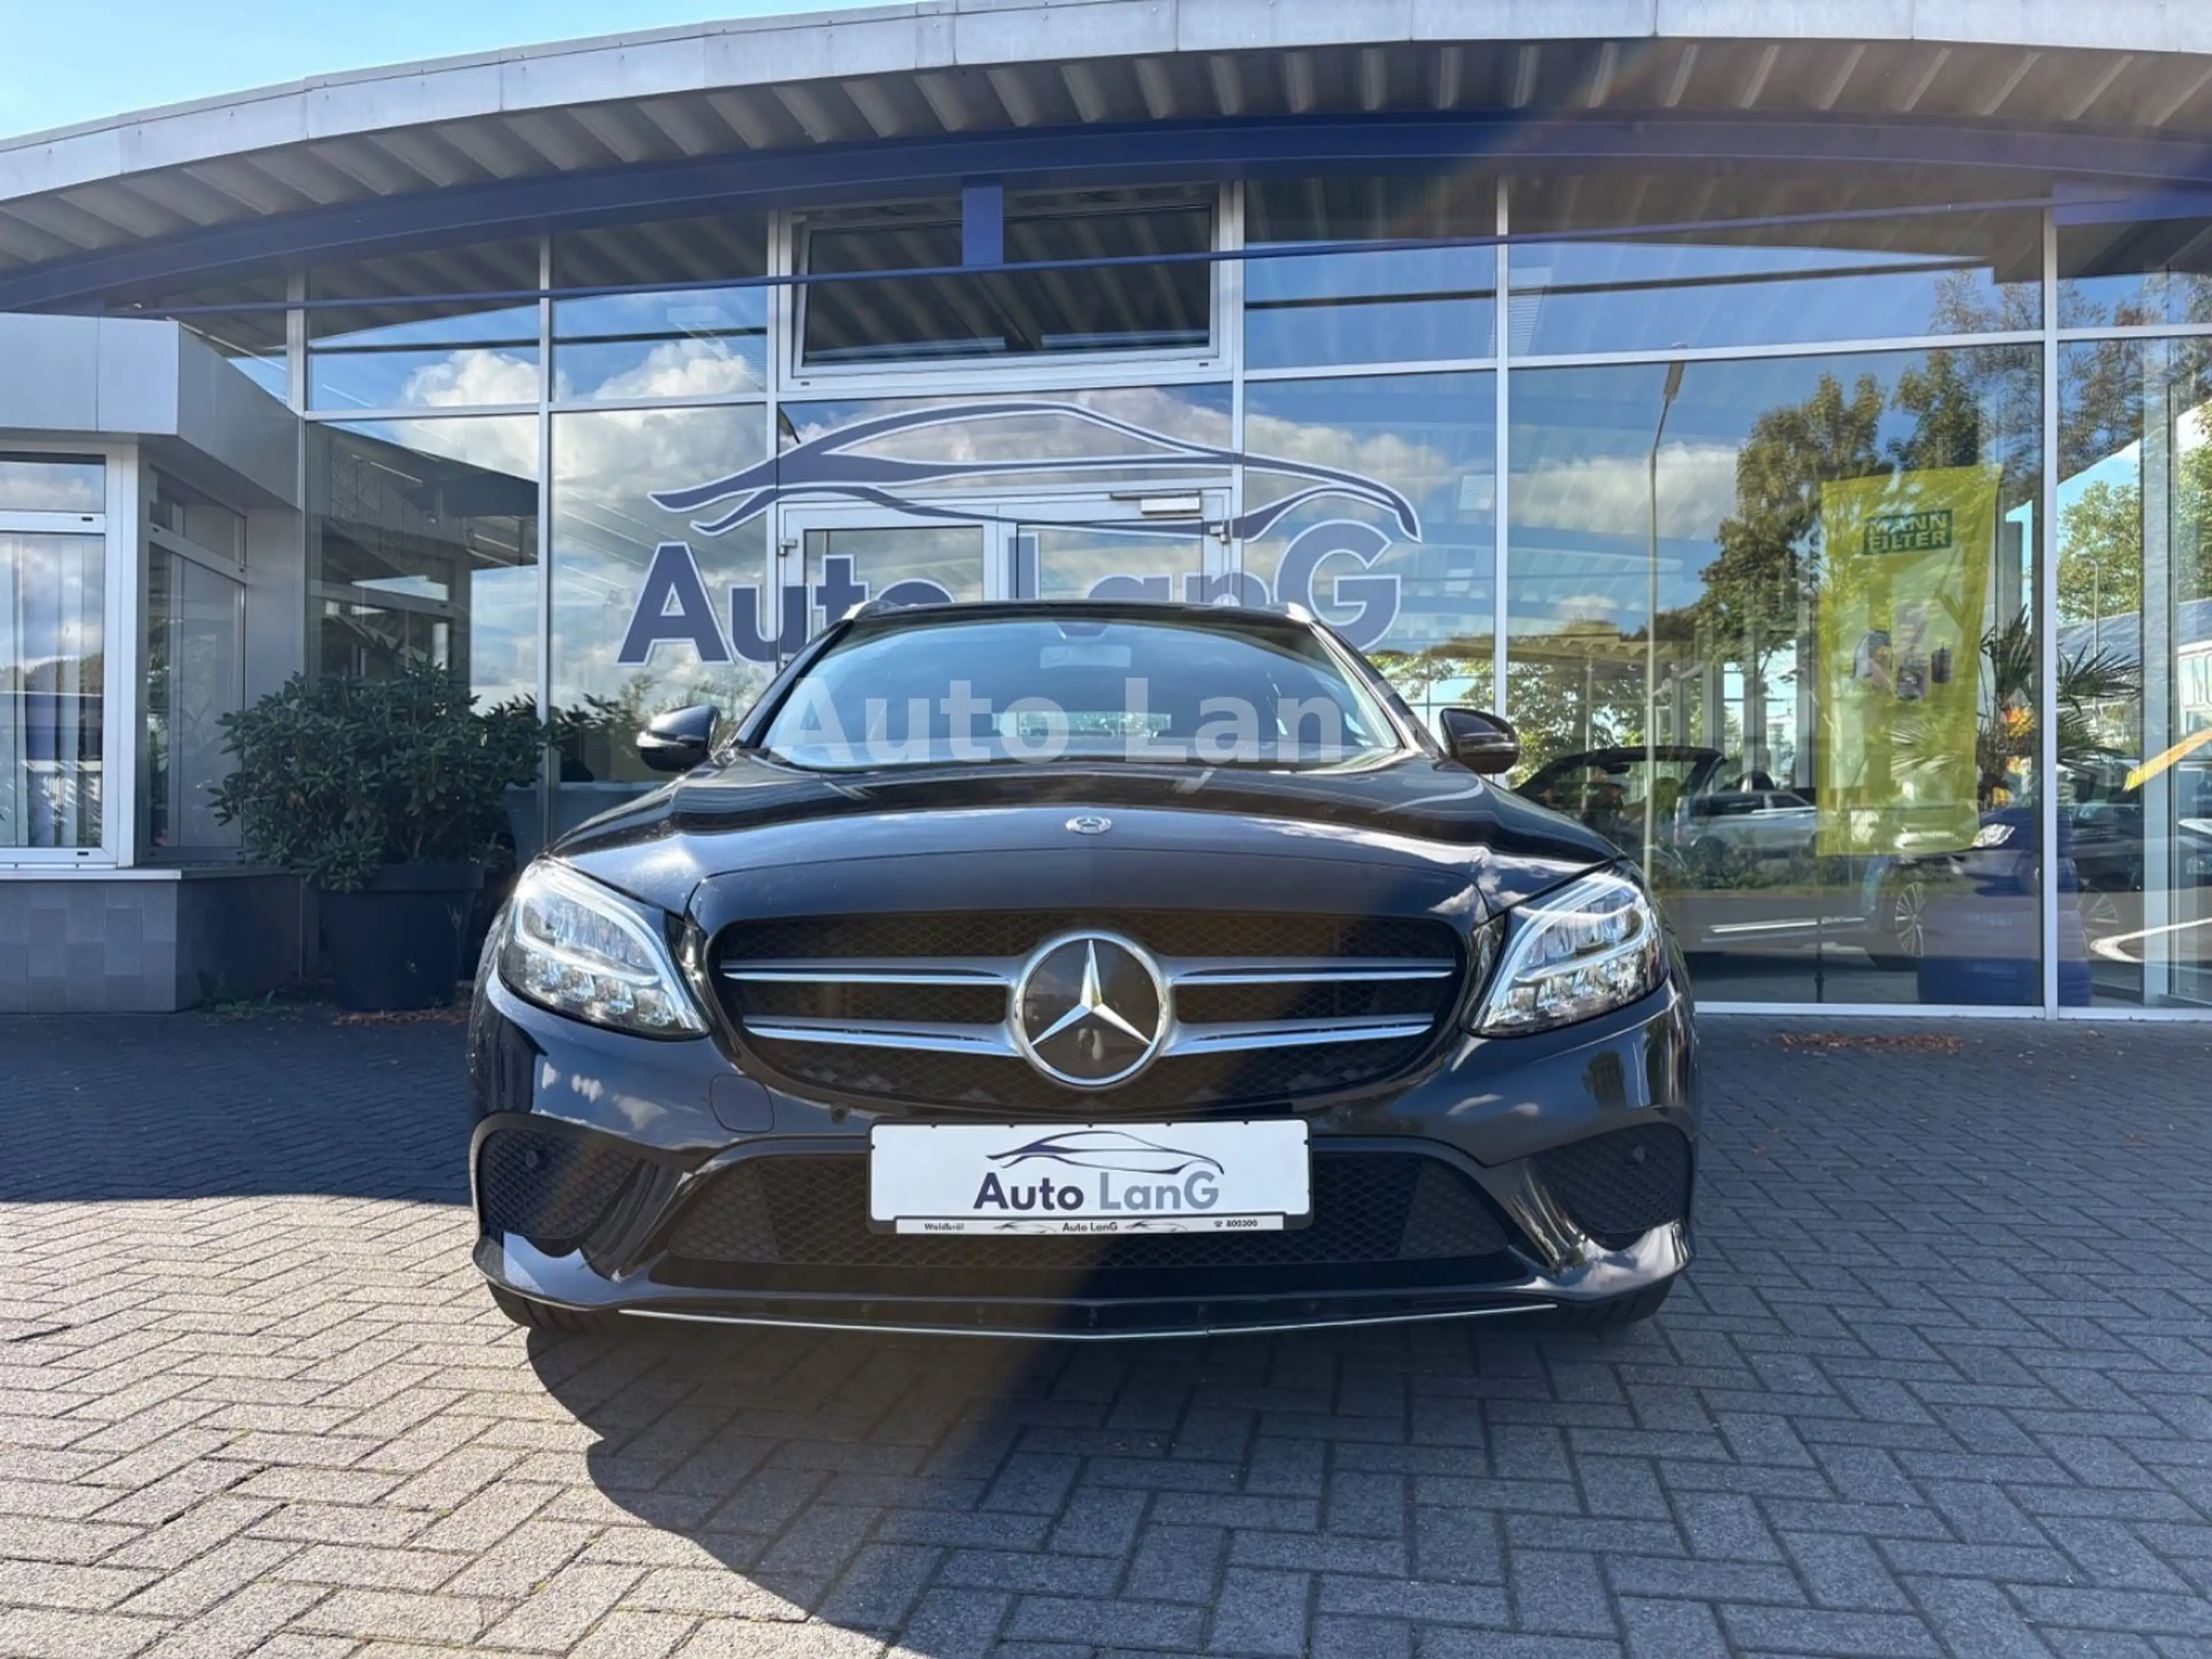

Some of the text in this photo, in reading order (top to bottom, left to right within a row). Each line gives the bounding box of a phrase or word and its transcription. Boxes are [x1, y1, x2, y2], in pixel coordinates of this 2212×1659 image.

[1870, 513, 1947, 535] MANN
[1869, 530, 1947, 550] FILTER
[616, 541, 955, 665] Aut
[974, 1171, 1219, 1210] Auto LanG
[1062, 1222, 1088, 1232] Auto
